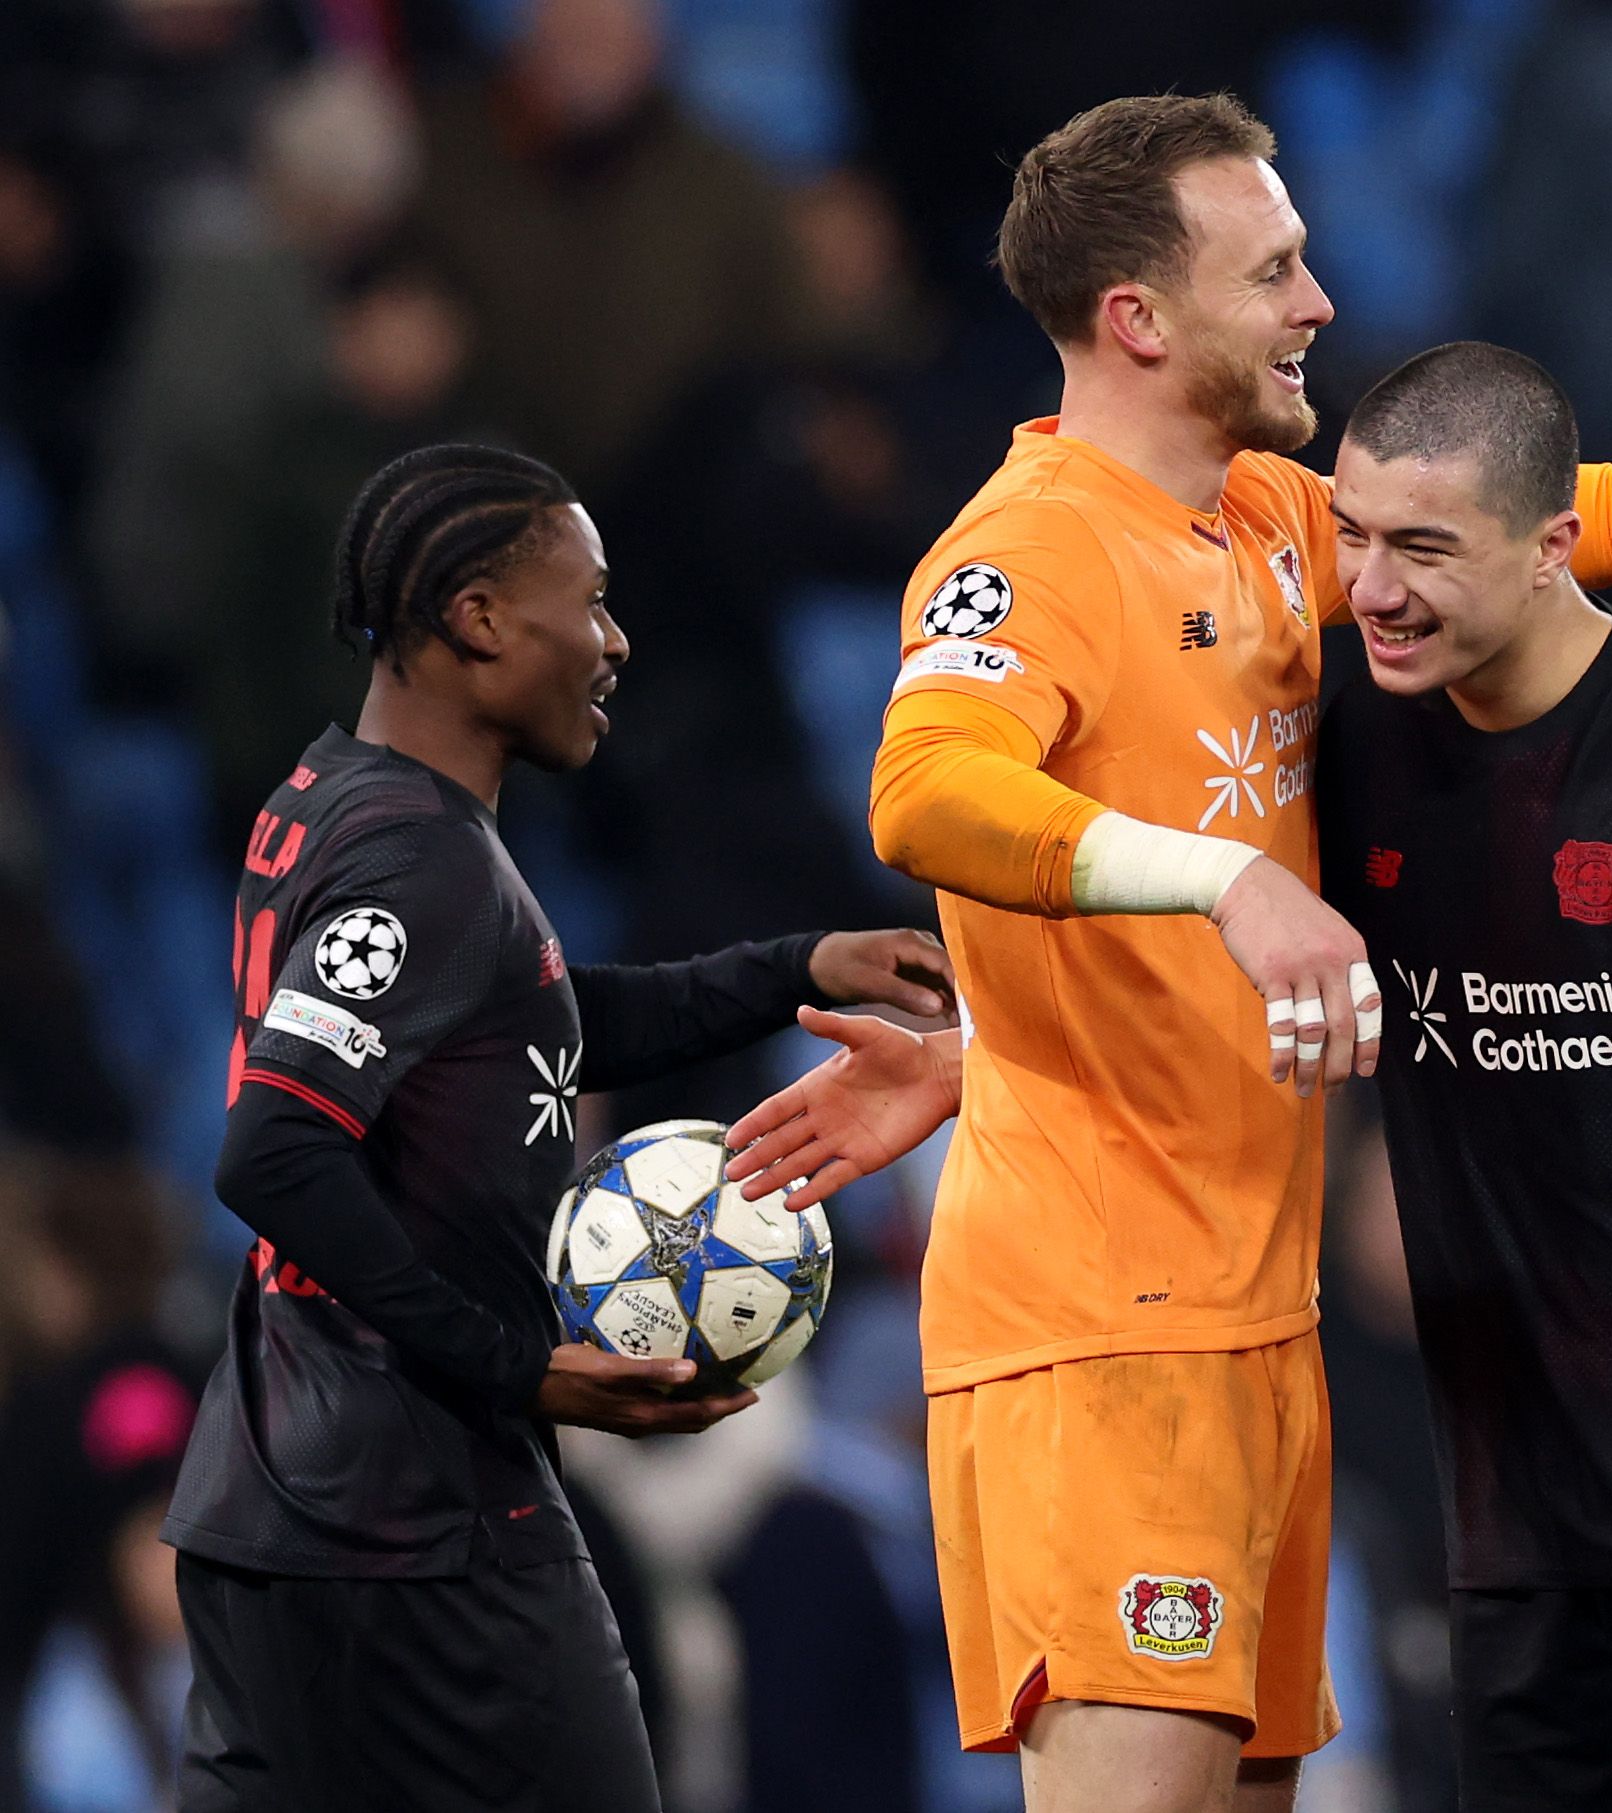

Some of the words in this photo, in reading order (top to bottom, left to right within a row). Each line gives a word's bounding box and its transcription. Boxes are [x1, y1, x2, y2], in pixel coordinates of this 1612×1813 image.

[1274, 751, 1314, 808] Goth
[634, 1293, 676, 1320] LEAGUE
[1149, 1292, 1171, 1303] DRY
[618, 1291, 683, 1334] CHAMPIONS
[1163, 1585, 1184, 1595] 1904
[1153, 1613, 1193, 1624] BAYER
[1169, 1599, 1178, 1638] BAYER
[1139, 1636, 1203, 1652] Leverkusen
